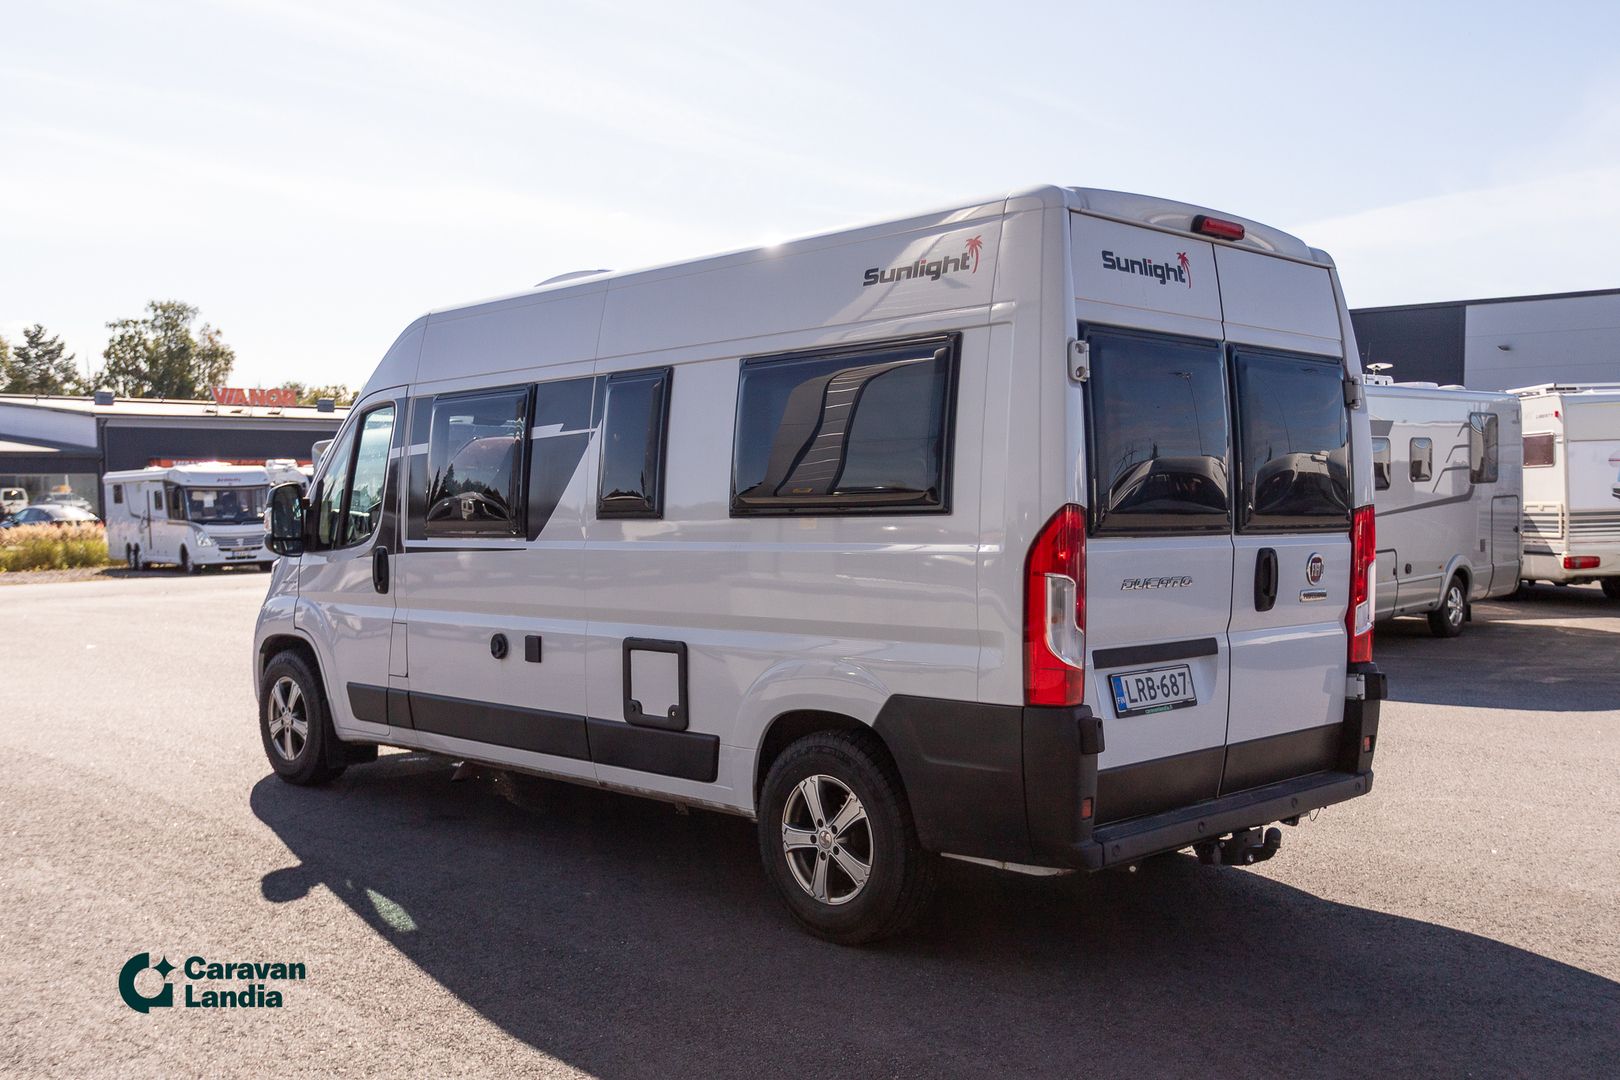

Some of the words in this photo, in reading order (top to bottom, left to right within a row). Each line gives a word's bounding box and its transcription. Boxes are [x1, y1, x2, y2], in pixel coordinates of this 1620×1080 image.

[863, 252, 970, 287] Sunlight
[1101, 250, 1186, 285] Sunlight
[211, 387, 297, 407] VIANOR
[1120, 575, 1193, 591] DUCATO
[1125, 672, 1186, 703] LRB-687
